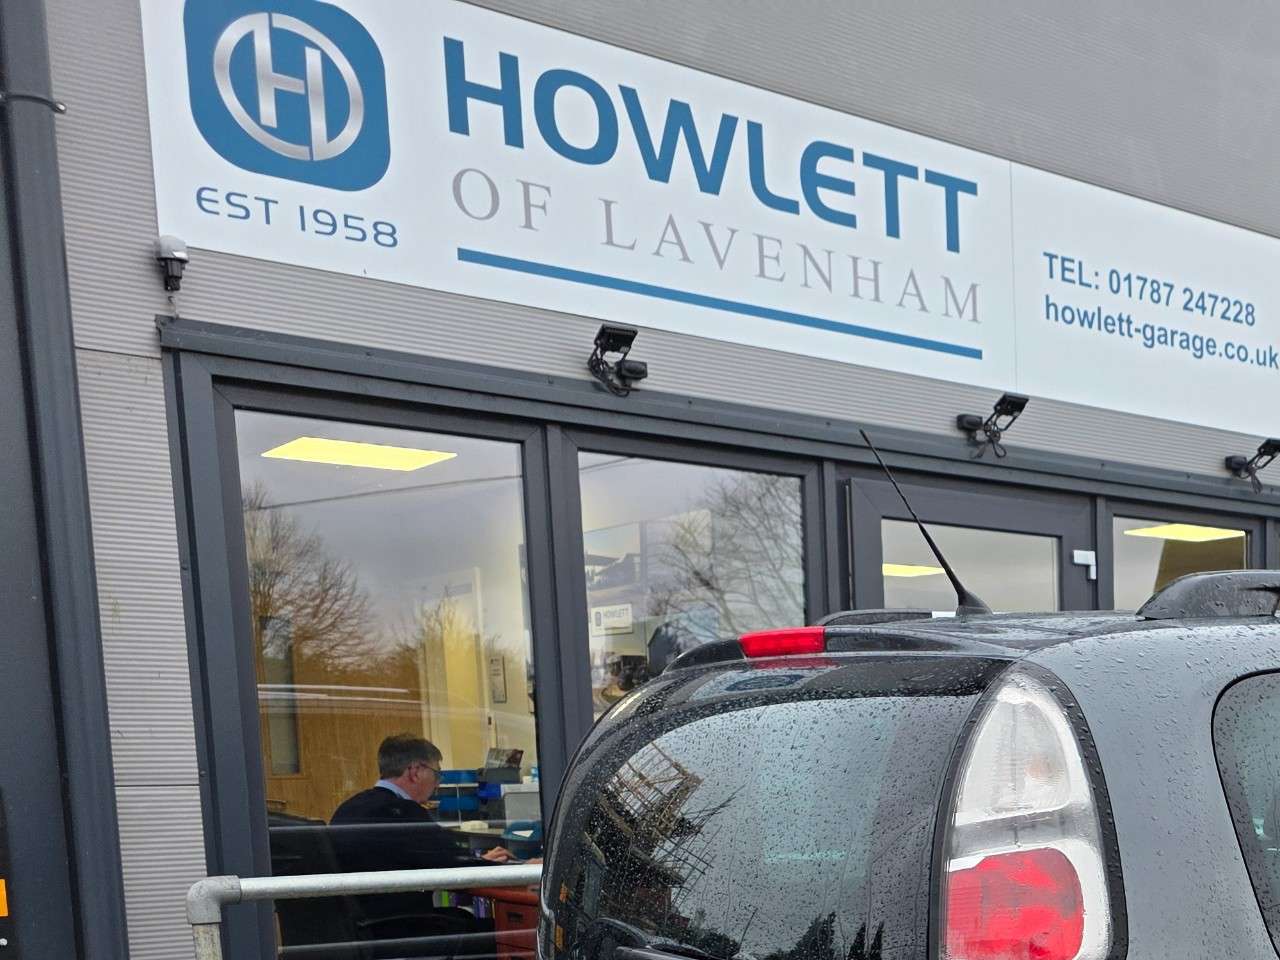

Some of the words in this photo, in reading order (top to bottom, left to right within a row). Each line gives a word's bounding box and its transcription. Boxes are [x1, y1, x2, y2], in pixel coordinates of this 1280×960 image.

[443, 36, 978, 253] HOWLETT
[196, 186, 280, 226] EST
[299, 205, 399, 249] 1958
[452, 167, 553, 231] OF
[600, 197, 983, 325] LAVENHAM
[1043, 251, 1100, 292] TEL:
[1108, 268, 1175, 307] 01787
[1182, 286, 1257, 328] 247228
[1045, 294, 1280, 371] howlett-garage.co.uk
